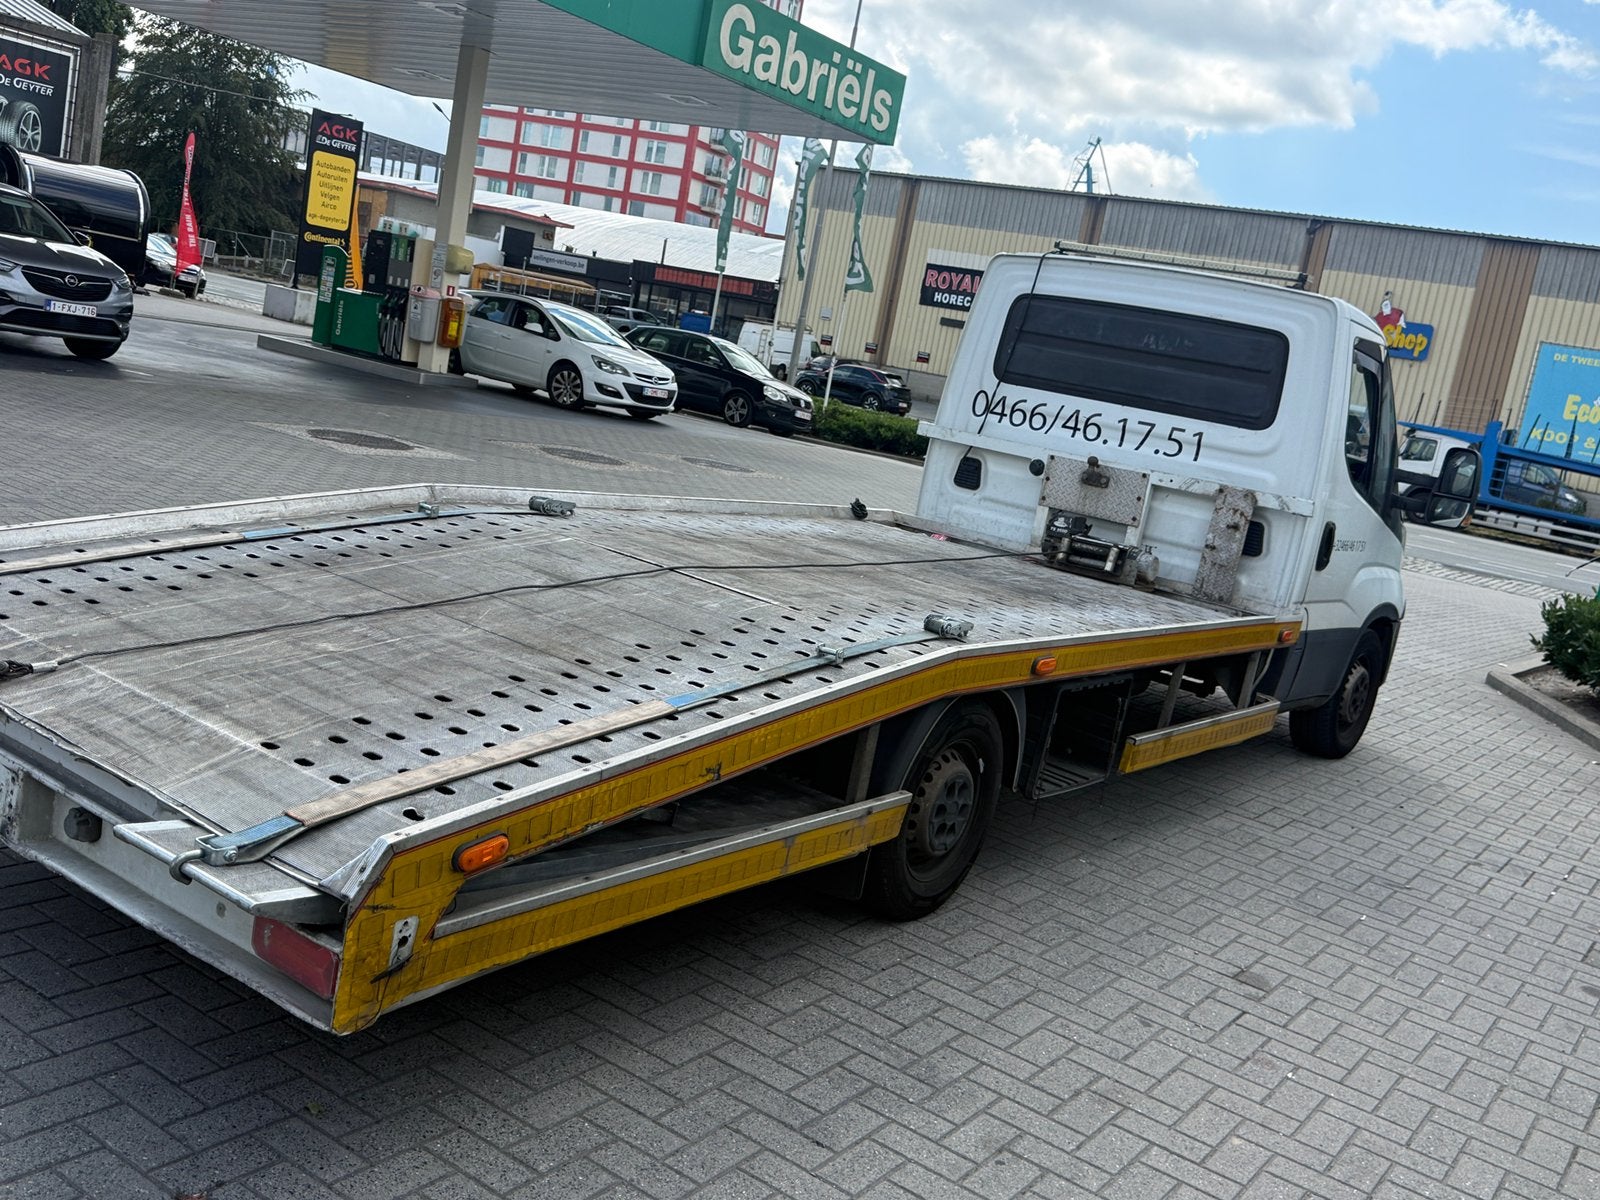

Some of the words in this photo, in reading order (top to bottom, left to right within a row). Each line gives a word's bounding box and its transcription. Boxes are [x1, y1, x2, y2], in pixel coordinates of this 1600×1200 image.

[0, 54, 51, 80] AGK
[720, 3, 893, 132] Gabriëls
[318, 121, 359, 142] AGK
[316, 160, 351, 174] Autobanden
[317, 170, 348, 183] Autoruiten
[319, 180, 344, 193] Uitlijnen
[320, 190, 340, 202] Velgen
[321, 201, 337, 210] Airco
[185, 214, 194, 233] RAIN
[304, 231, 341, 246] Continental
[533, 254, 585, 269] veilingen-verkoop.be
[52, 302, 96, 316] 1-FXJ-716
[1383, 324, 1428, 357] Shop
[1553, 353, 1569, 363] DE
[971, 389, 1204, 462] 0466/46.17.51
[1584, 436, 1596, 449] &
